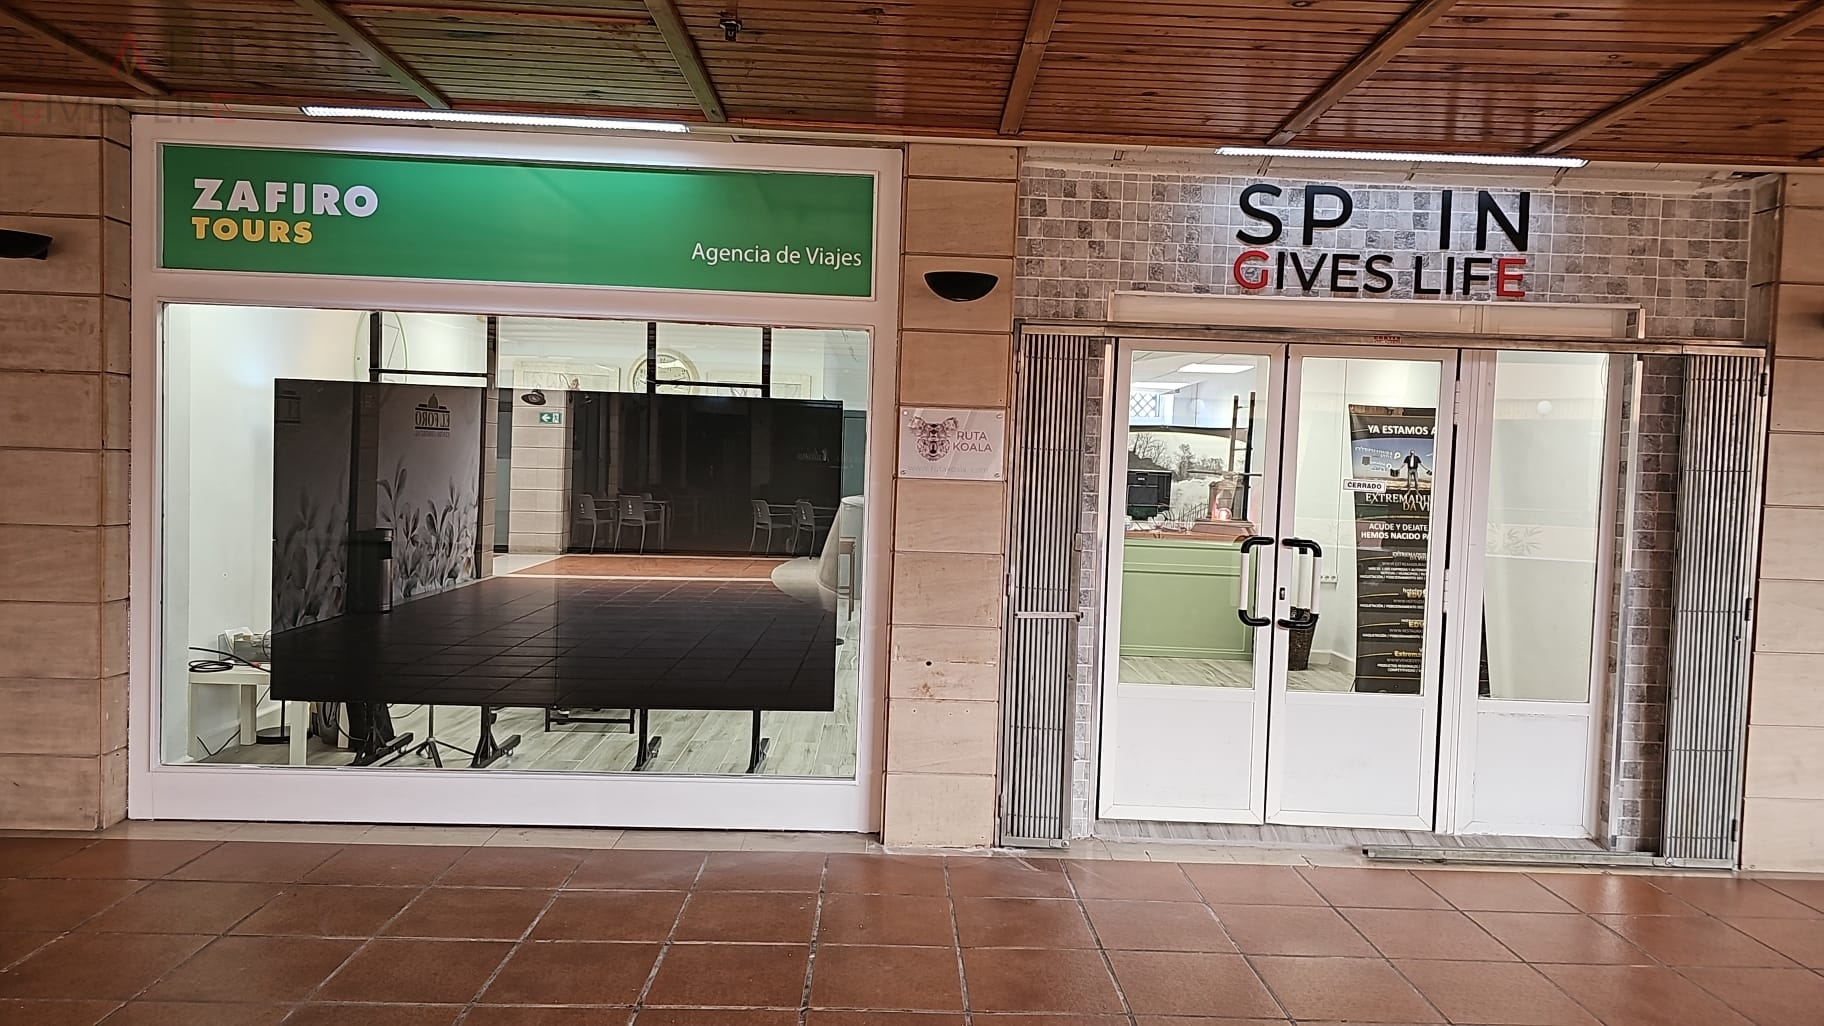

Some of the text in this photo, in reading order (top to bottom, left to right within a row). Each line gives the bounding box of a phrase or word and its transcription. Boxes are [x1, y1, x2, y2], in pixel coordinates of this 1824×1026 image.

[192, 178, 379, 217] ZAFIRO
[191, 216, 313, 244] TOURS
[691, 242, 862, 270] Agencia de Viajes
[1233, 250, 1527, 298] GIVES LIFE
[1367, 424, 1380, 434] YA
[1382, 425, 1429, 435] ESTAMOS
[956, 431, 988, 441] RUTA
[952, 442, 993, 453] KOALA
[1347, 481, 1382, 490] CERRADO
[1369, 523, 1395, 531] ACUDE
[1361, 531, 1389, 539] HEMOS
[1390, 532, 1421, 540] NACIDO
